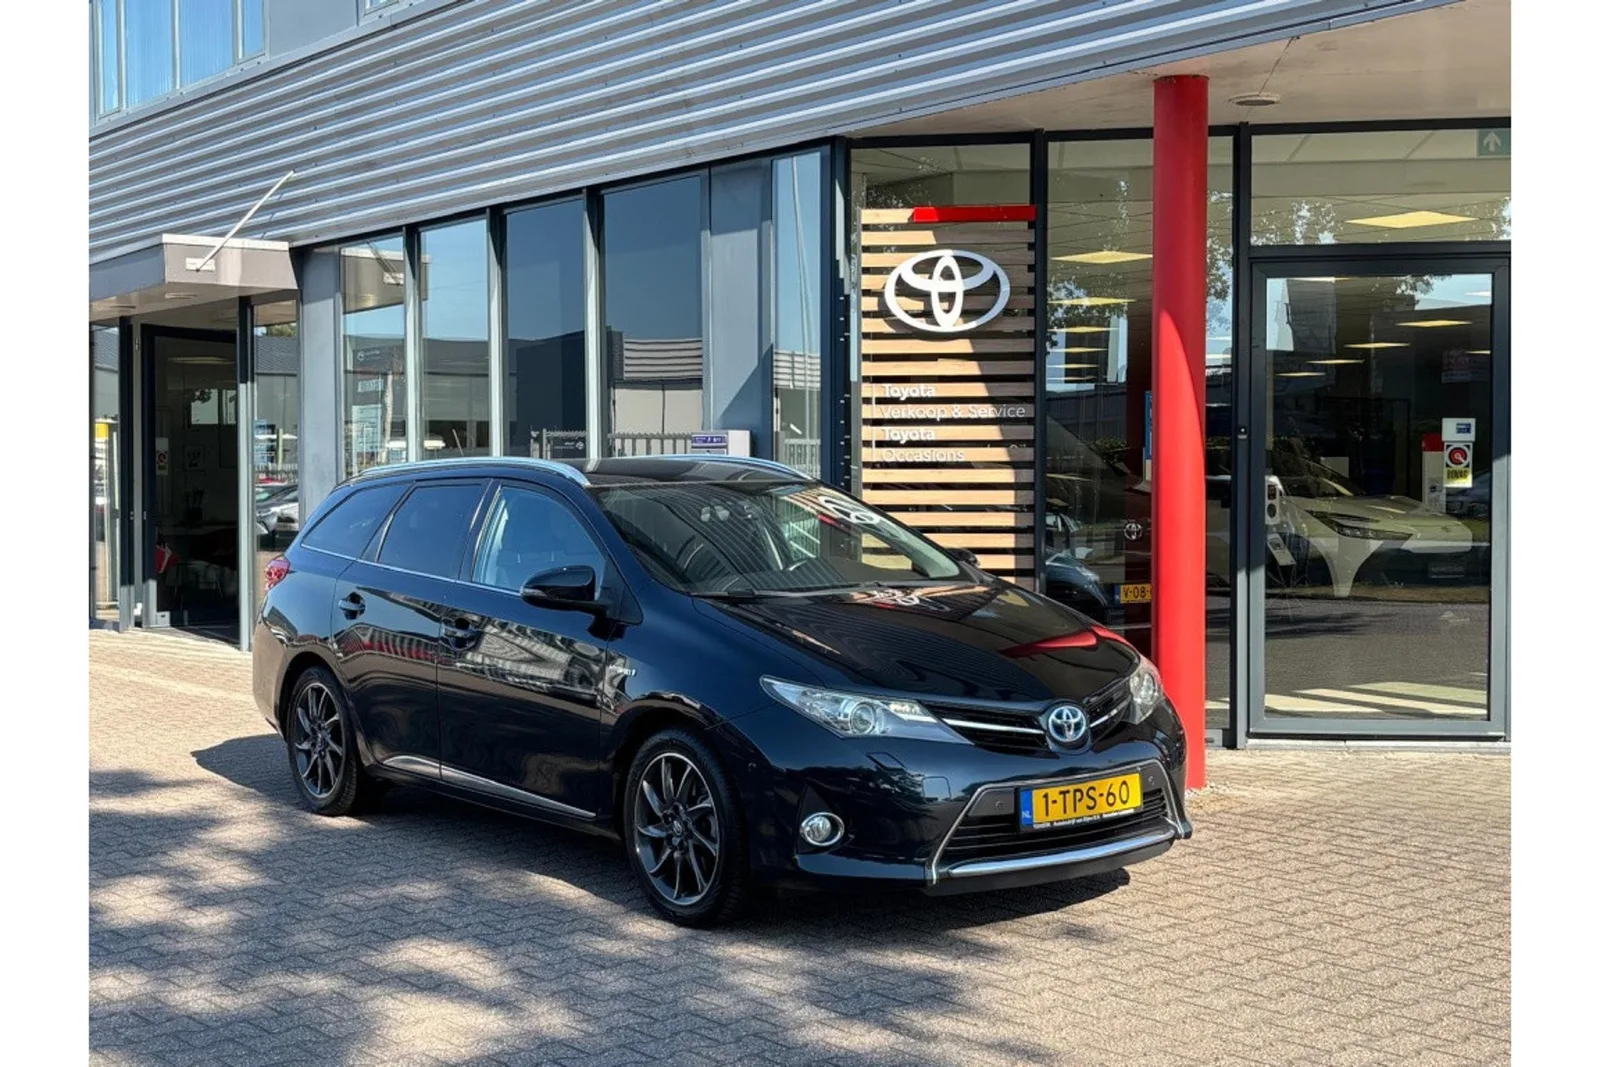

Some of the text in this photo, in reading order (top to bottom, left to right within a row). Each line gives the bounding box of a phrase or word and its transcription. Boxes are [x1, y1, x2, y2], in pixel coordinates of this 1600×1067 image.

[883, 383, 936, 401] Toyota
[881, 404, 1026, 421] Verkoop & Service
[883, 426, 936, 444] Toyota
[882, 449, 966, 462] Occasions
[1042, 780, 1130, 817] 1-TPS-60
